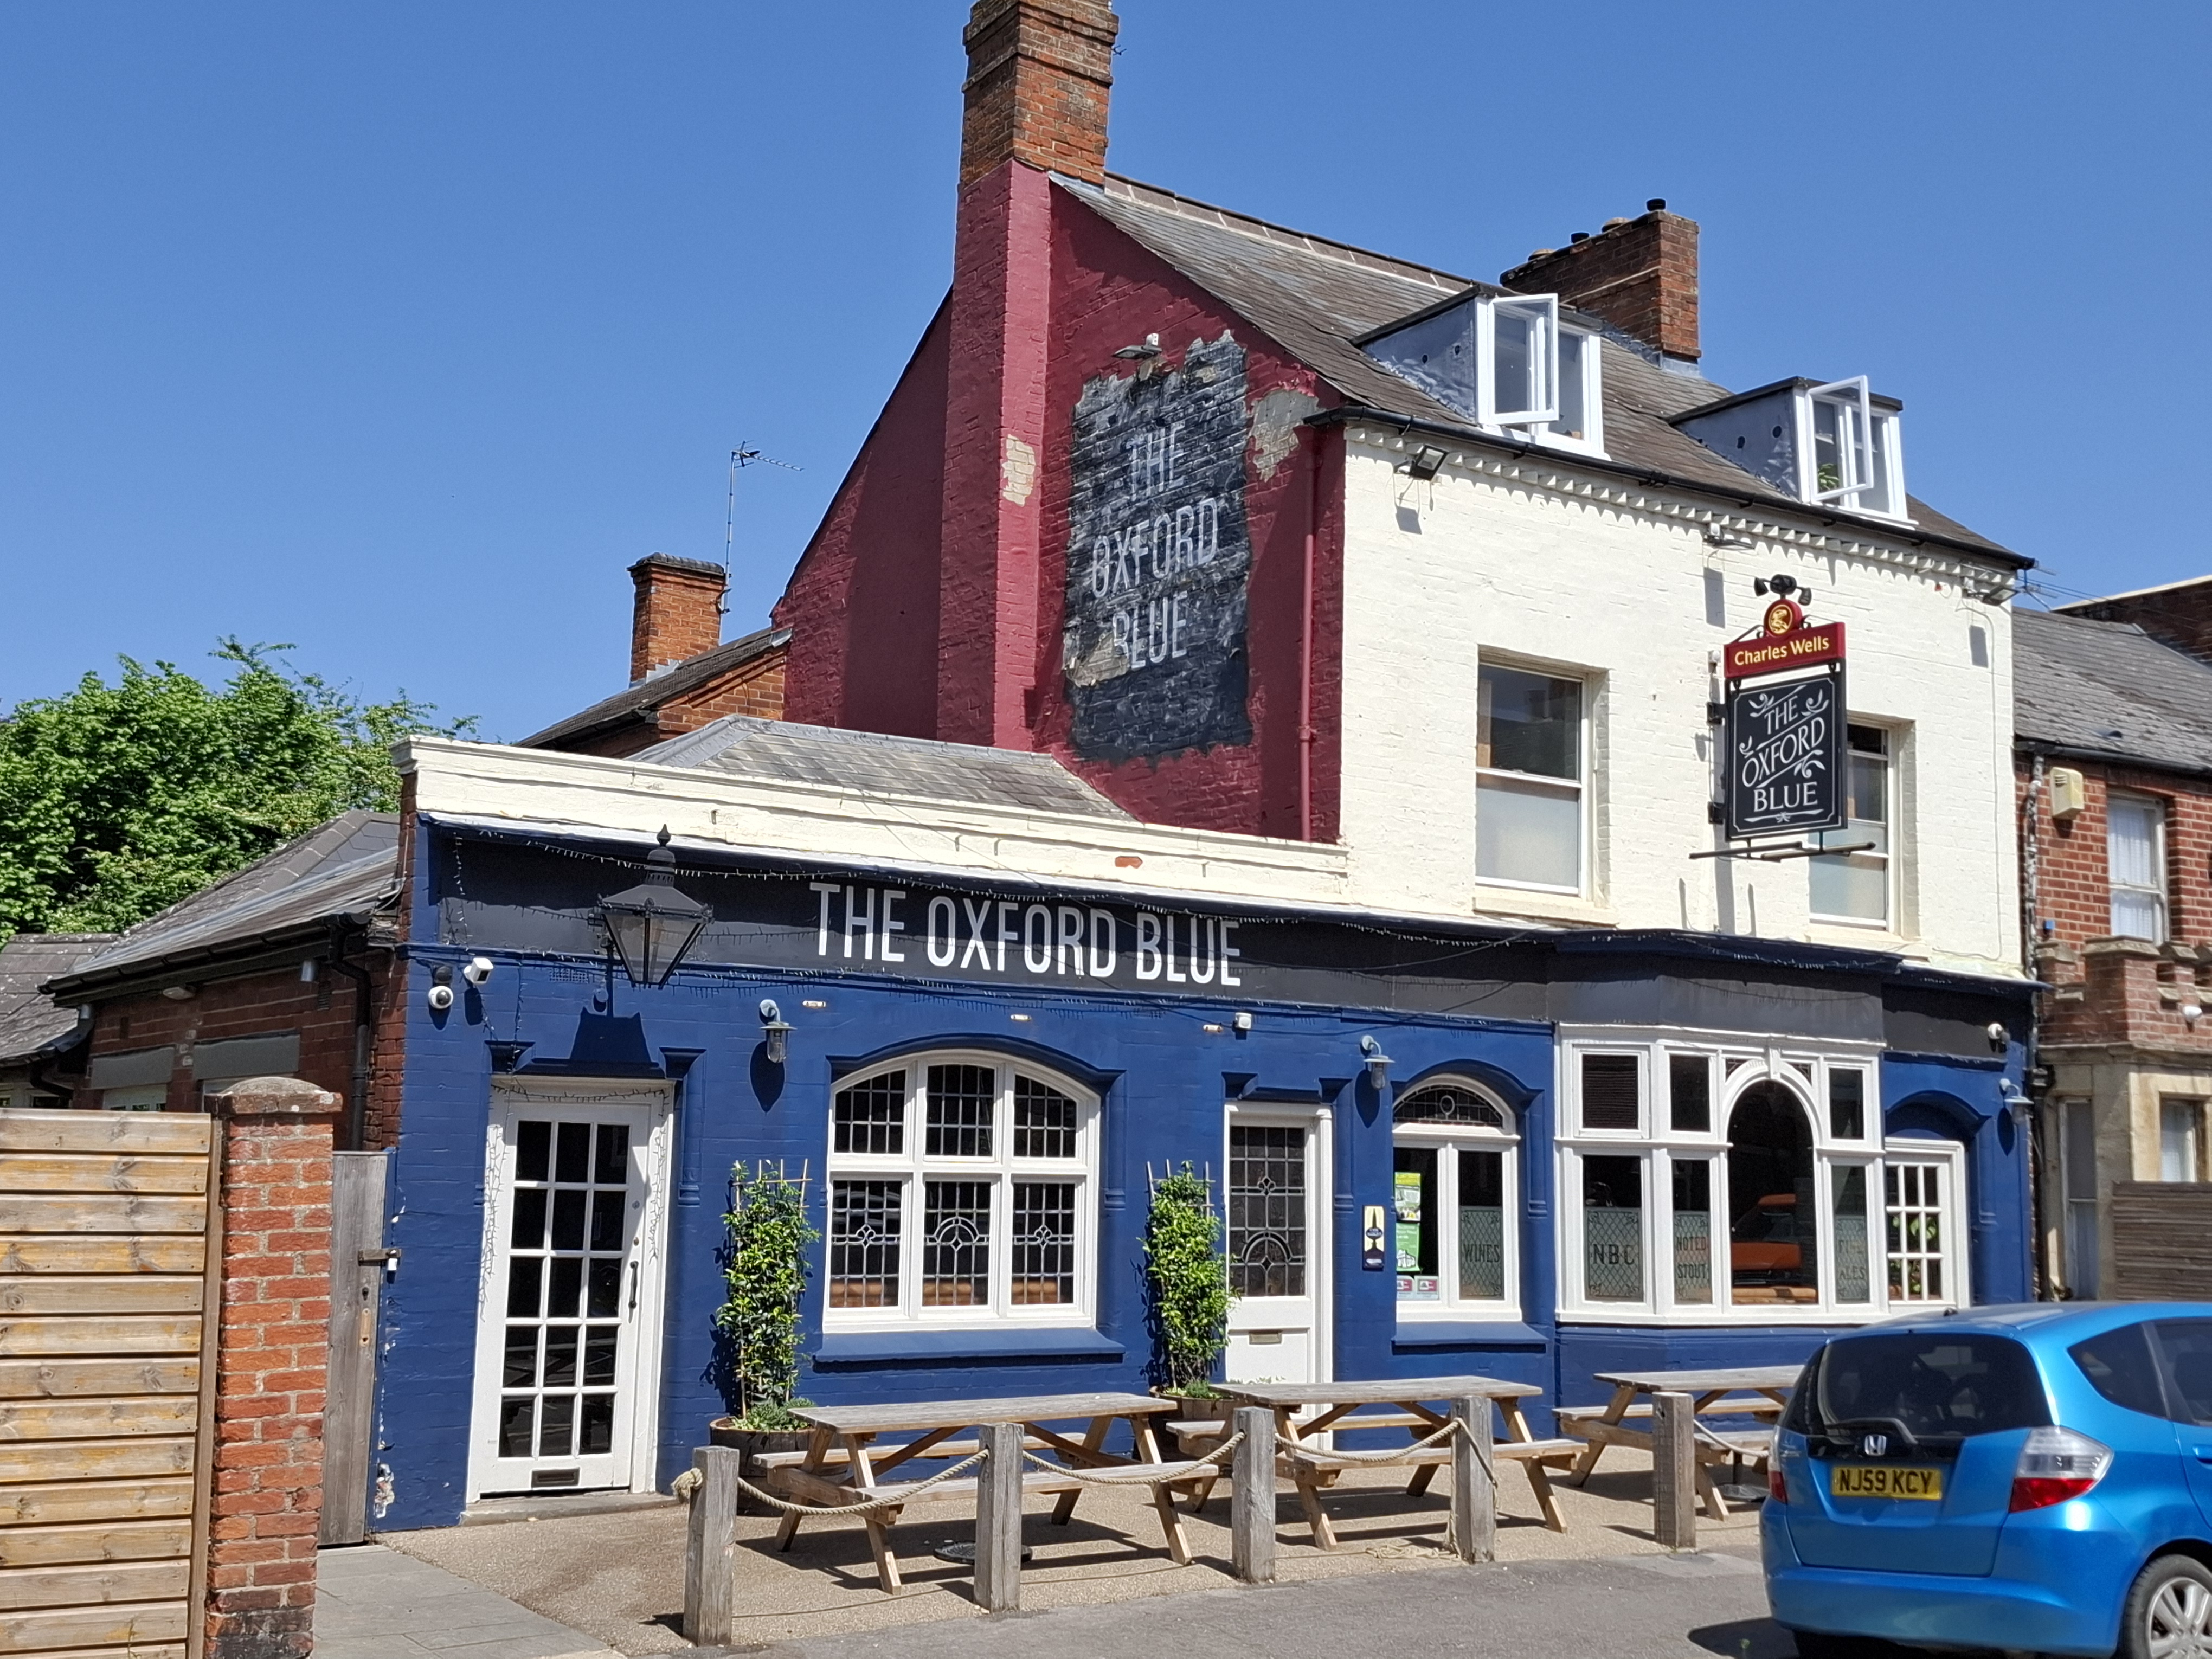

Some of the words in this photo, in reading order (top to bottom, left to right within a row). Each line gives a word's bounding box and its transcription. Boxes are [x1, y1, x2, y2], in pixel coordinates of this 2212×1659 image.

[1126, 420, 1186, 501] THE
[1091, 498, 1219, 599] OXFORD
[1113, 590, 1187, 670] BLUE
[1734, 645, 1787, 666] Charles
[1790, 636, 1829, 655] Wells
[1764, 695, 1798, 735] THE
[1742, 717, 1825, 788] OXFORD
[1753, 781, 1818, 813] BLUE
[809, 882, 906, 962] THE
[927, 896, 1117, 978] OXFORD
[1136, 912, 1241, 986] BLUE
[1463, 1244, 1500, 1263] WINES
[1676, 1236, 1707, 1251] NOTED
[1677, 1263, 1707, 1279] STOUT
[1839, 1468, 1886, 1492] NJ59
[1892, 1470, 1933, 1495] KCY
